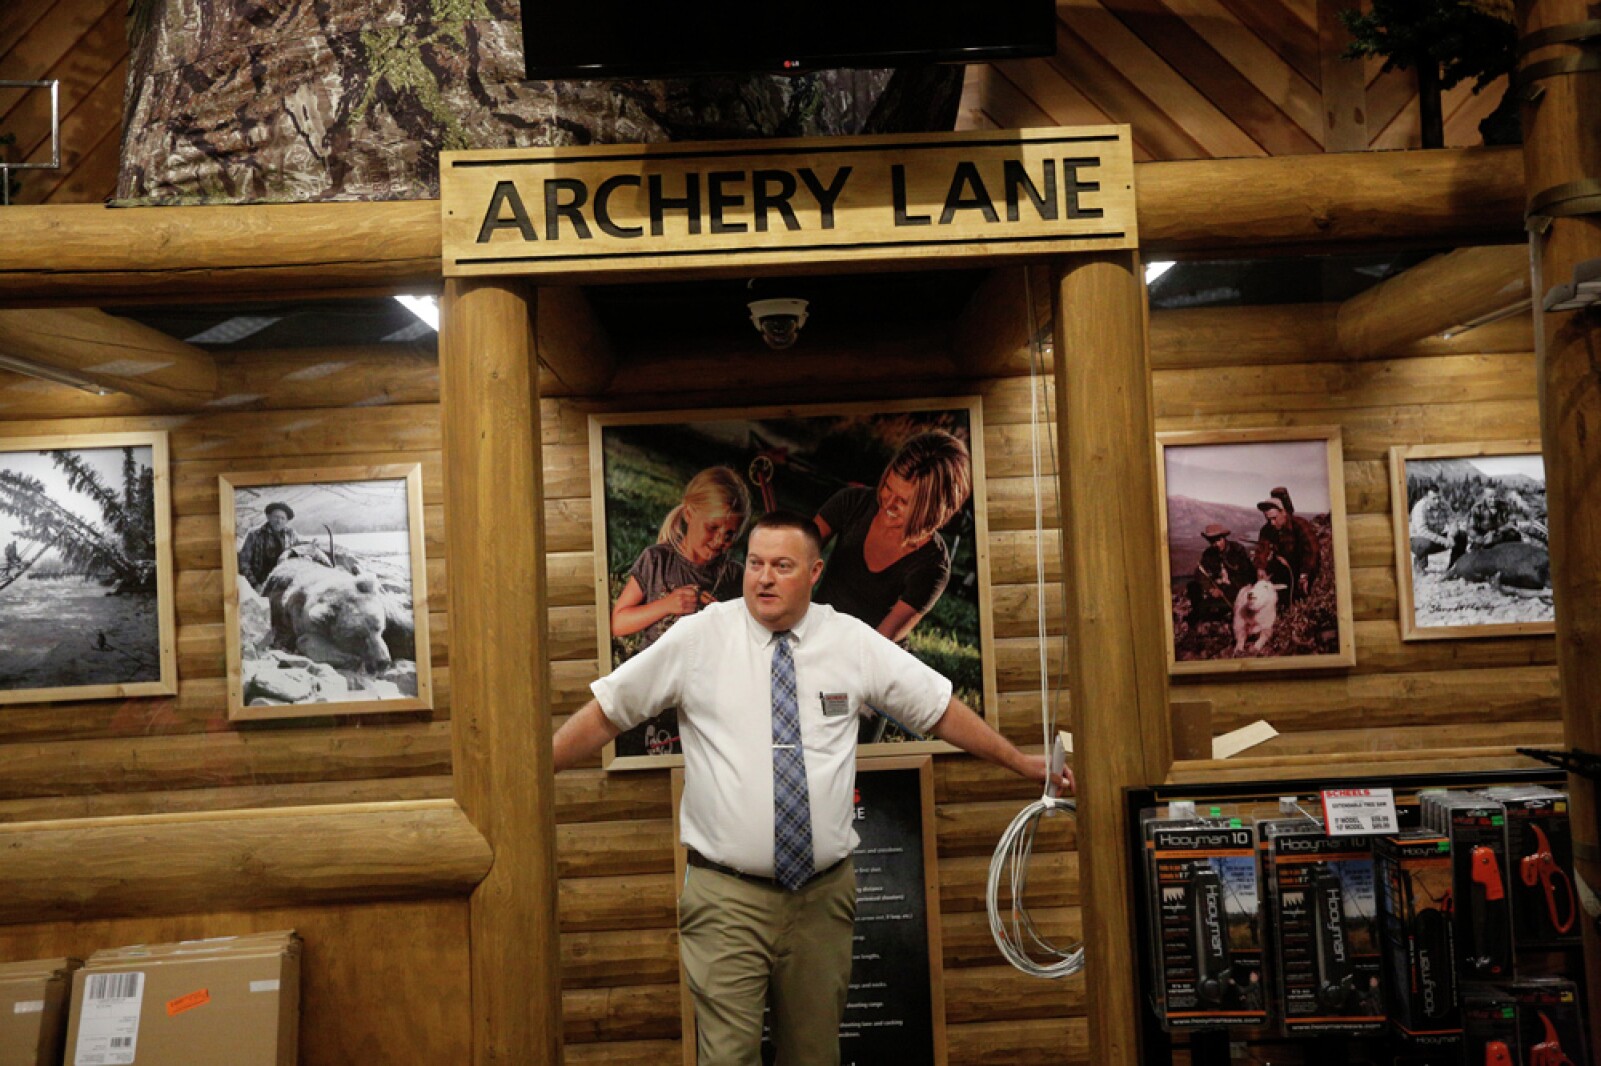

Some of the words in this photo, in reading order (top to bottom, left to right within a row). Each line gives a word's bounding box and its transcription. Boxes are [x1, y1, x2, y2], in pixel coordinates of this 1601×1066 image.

[476, 166, 852, 244] ARCHERY
[892, 156, 1105, 226] LANE
[1326, 789, 1370, 797] SCHEELS
[1160, 833, 1229, 848] Hooyman
[1232, 831, 1248, 844] 10
[1280, 837, 1346, 852] Hooyman
[1402, 847, 1447, 857] Hooyma
[1205, 884, 1223, 957] Hooyman
[1326, 888, 1346, 962] Hooyman
[1419, 949, 1437, 1018] Hooyman
[1415, 1036, 1461, 1045] Hooyman
